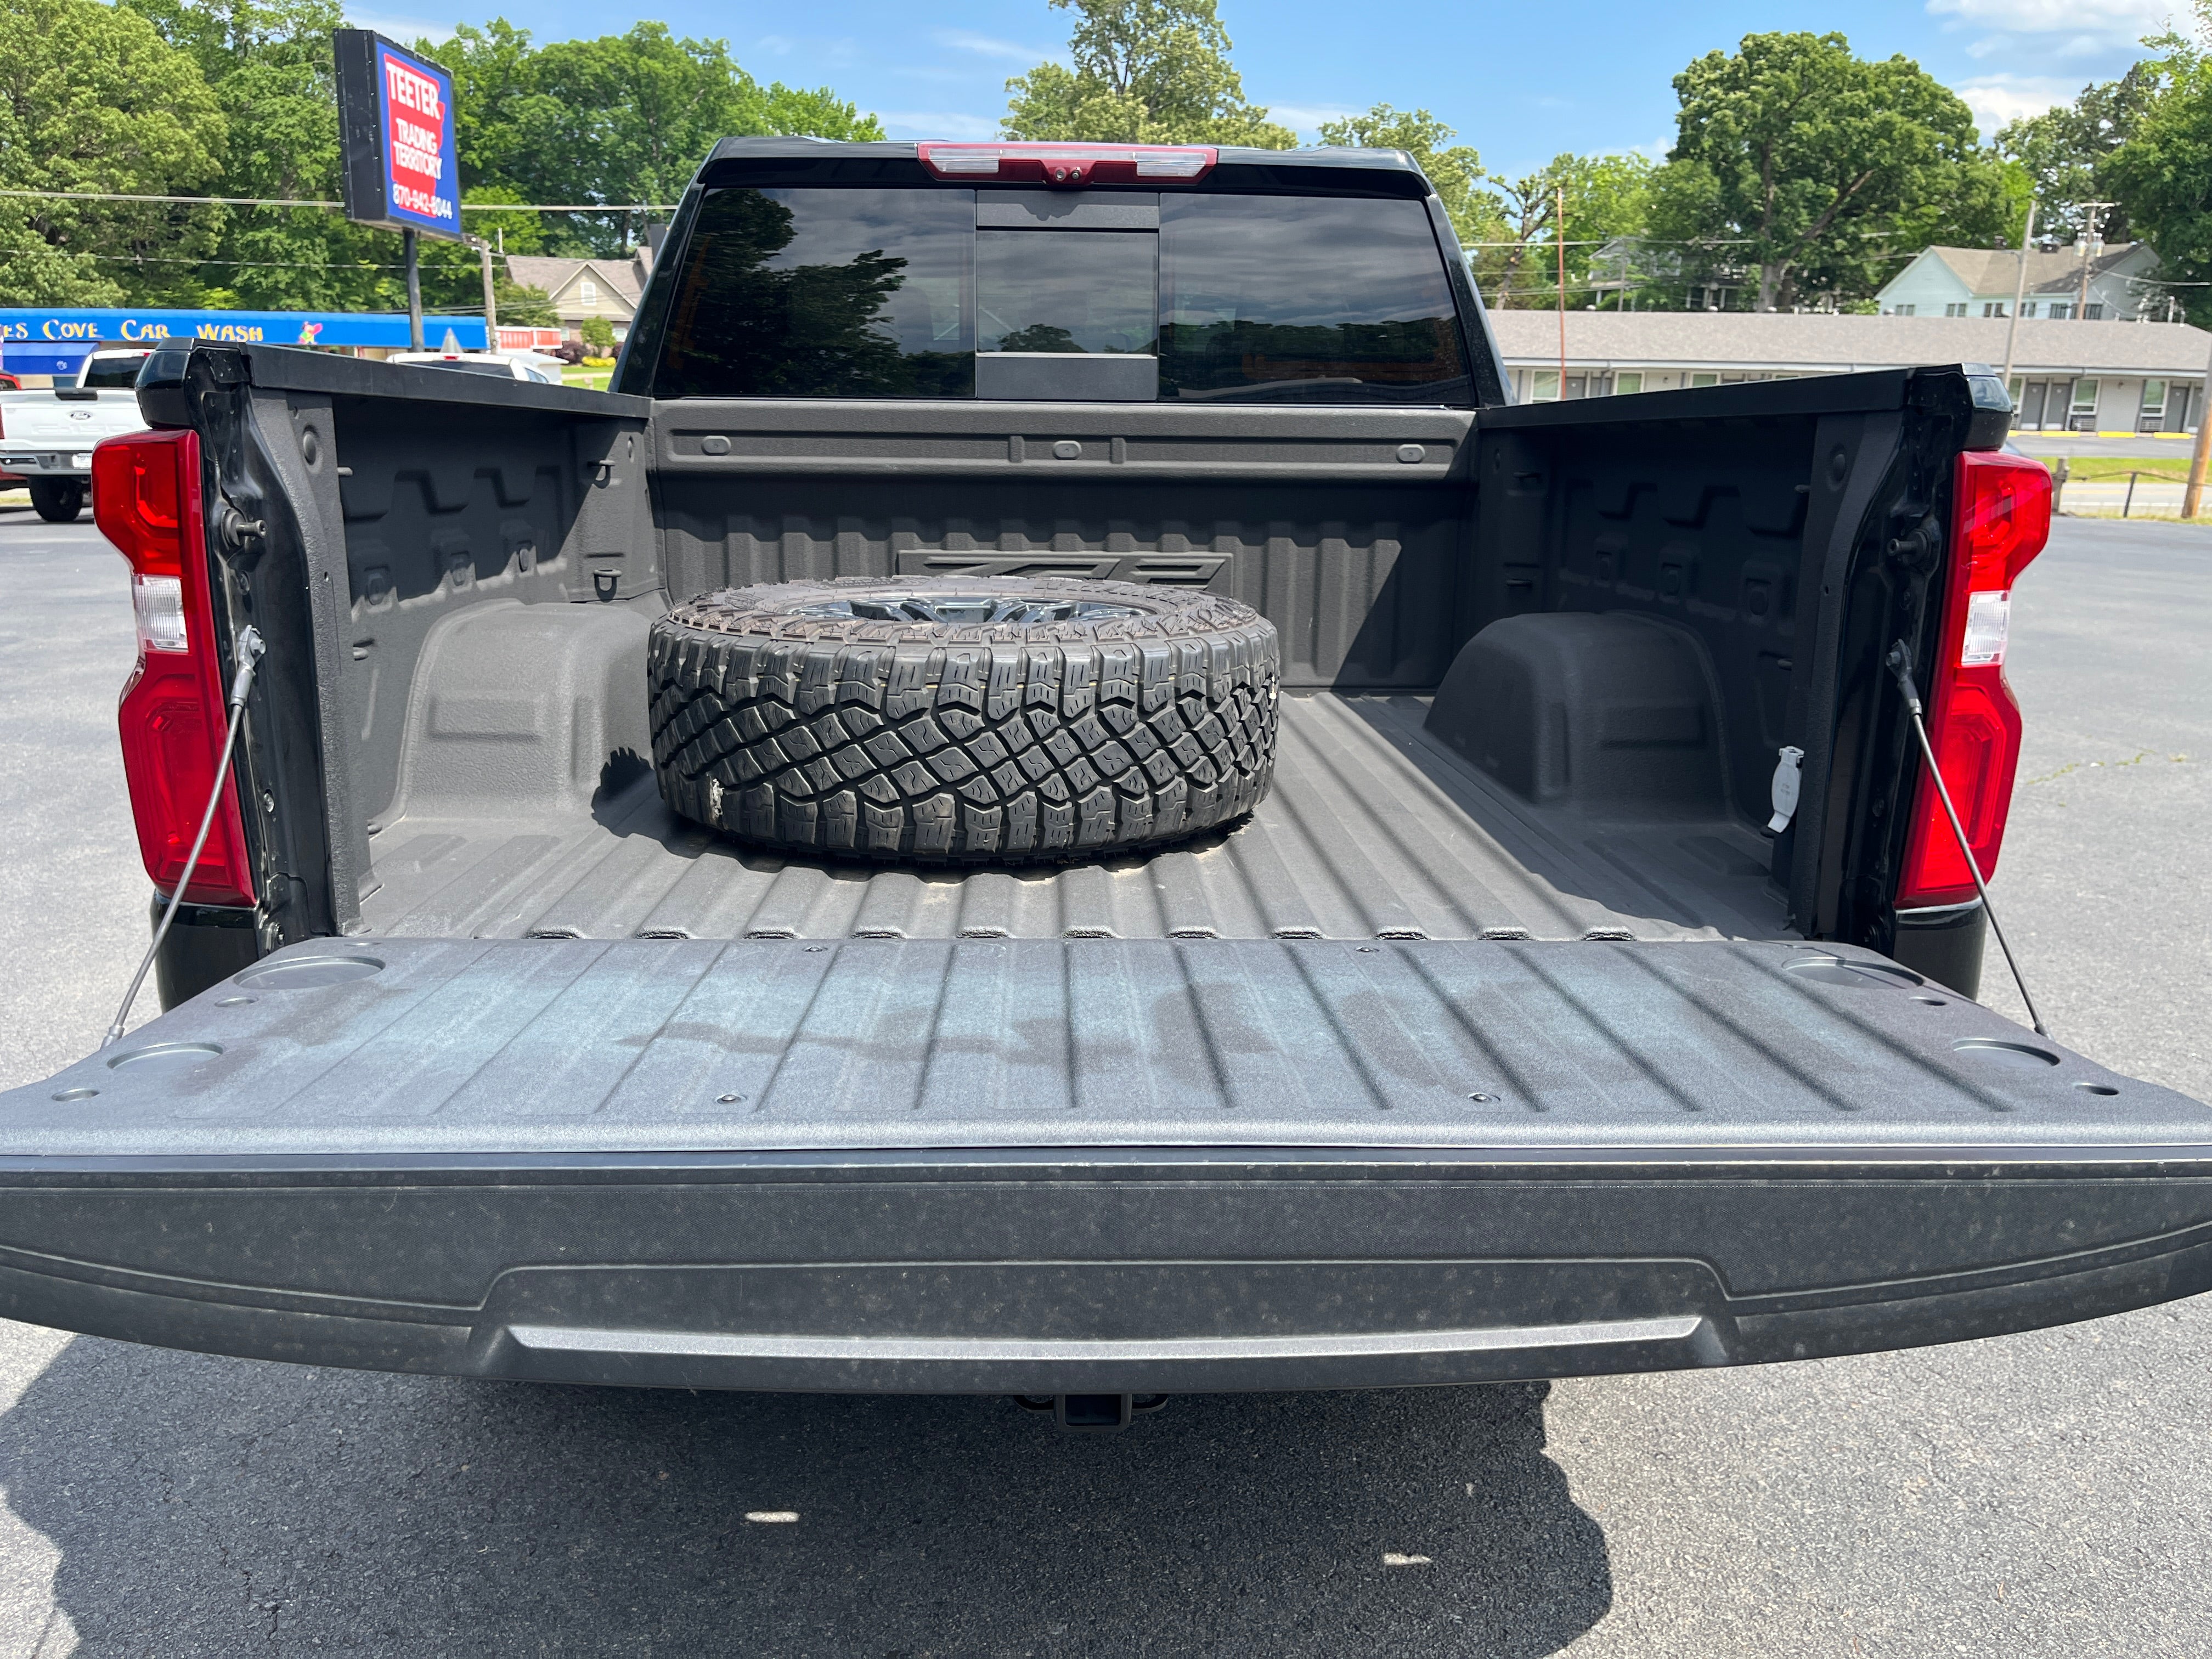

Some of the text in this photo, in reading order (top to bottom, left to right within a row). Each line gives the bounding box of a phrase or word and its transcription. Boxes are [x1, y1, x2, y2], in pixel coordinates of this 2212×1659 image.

[386, 61, 441, 120] TEETER
[396, 117, 437, 154] TRADING
[393, 140, 442, 180] TERRITORY
[42, 319, 104, 340] COVE
[121, 319, 171, 341] CAR
[196, 323, 264, 342] WASH
